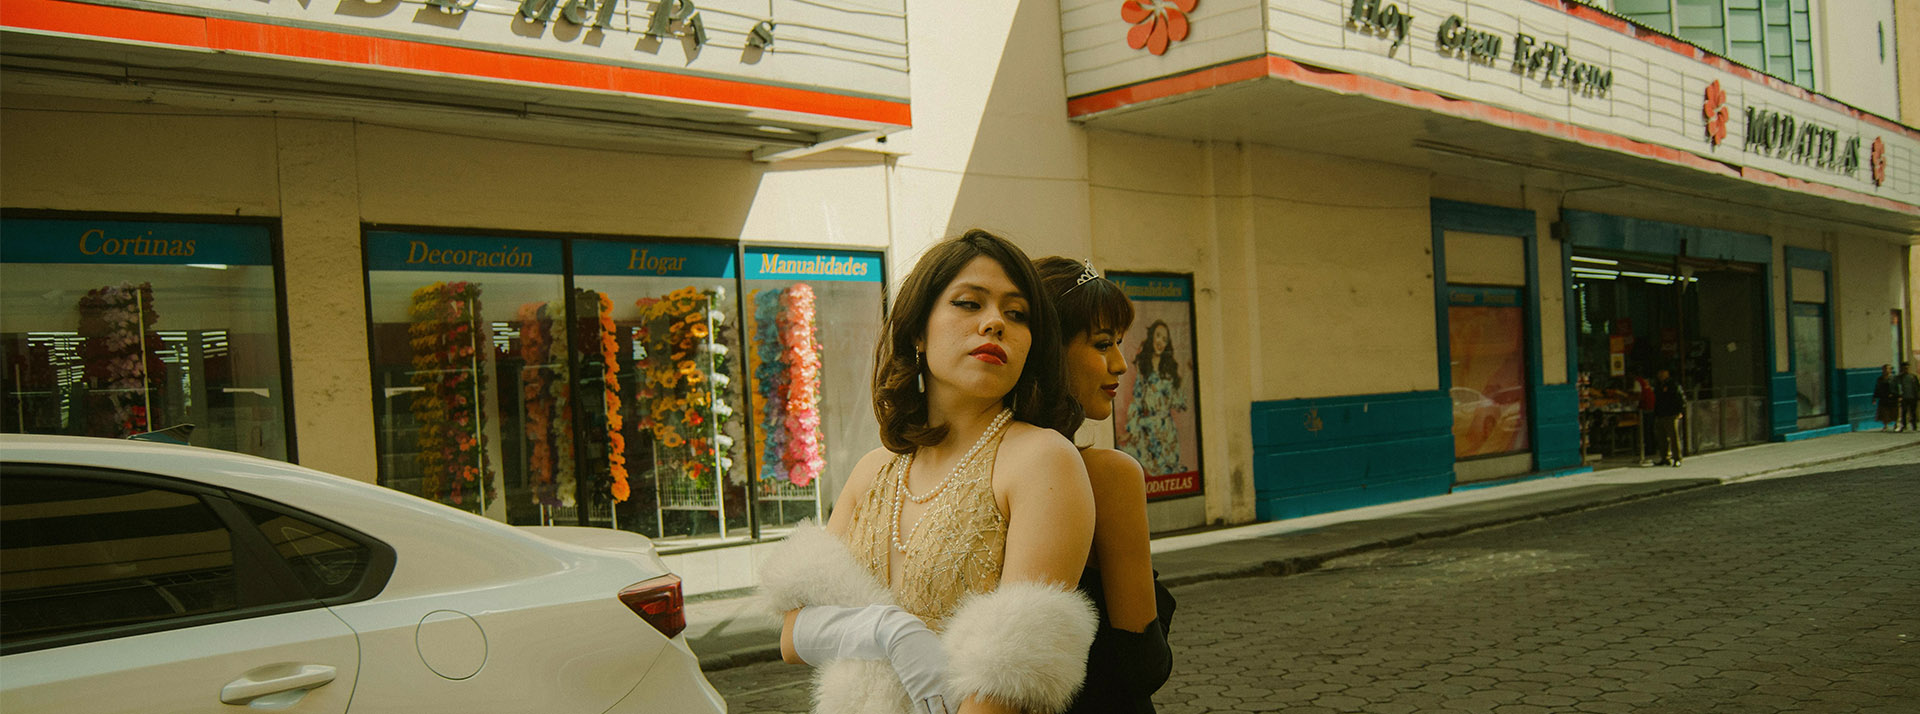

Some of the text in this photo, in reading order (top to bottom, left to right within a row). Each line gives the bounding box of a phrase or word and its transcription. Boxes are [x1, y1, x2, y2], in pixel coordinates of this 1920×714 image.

[1438, 14, 1502, 59] Gran
[1747, 106, 1860, 169] MODATELAS
[79, 229, 196, 257] Cortinas
[406, 240, 533, 268] Decoración
[628, 249, 687, 275] Hogar
[760, 253, 868, 276] Manualidades
[1146, 476, 1193, 494] ODATELAS
